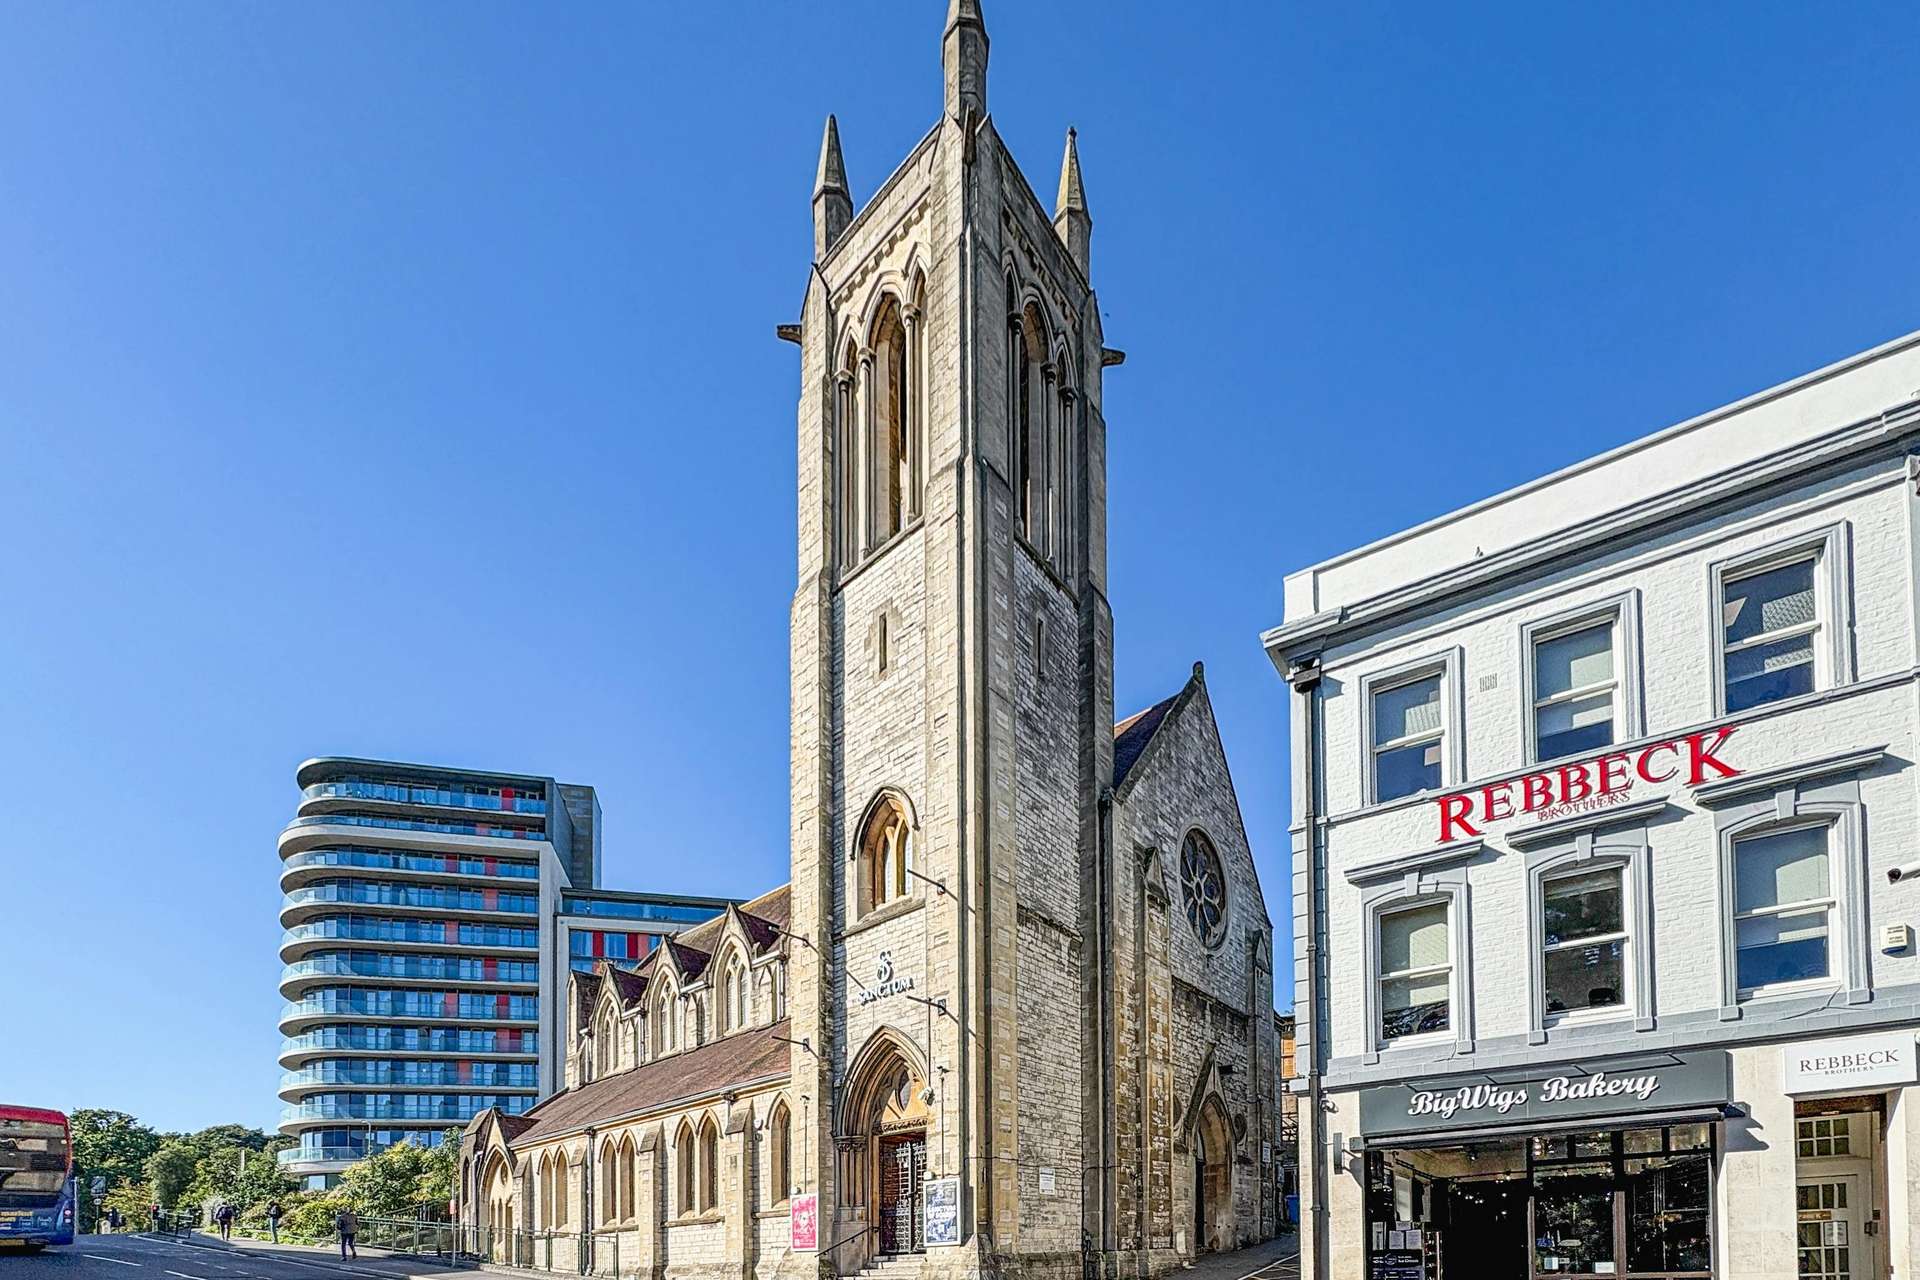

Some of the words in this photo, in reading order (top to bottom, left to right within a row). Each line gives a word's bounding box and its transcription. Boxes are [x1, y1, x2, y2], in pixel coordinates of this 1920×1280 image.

[1434, 724, 1746, 844] REBBECK
[1537, 790, 1631, 821] BROTHERS
[1799, 1048, 1899, 1072] REBBECK
[1824, 1065, 1874, 1076] BROTHERS
[1407, 1084, 1528, 1120] BigWigs
[1539, 1071, 1660, 1101] Bakery
